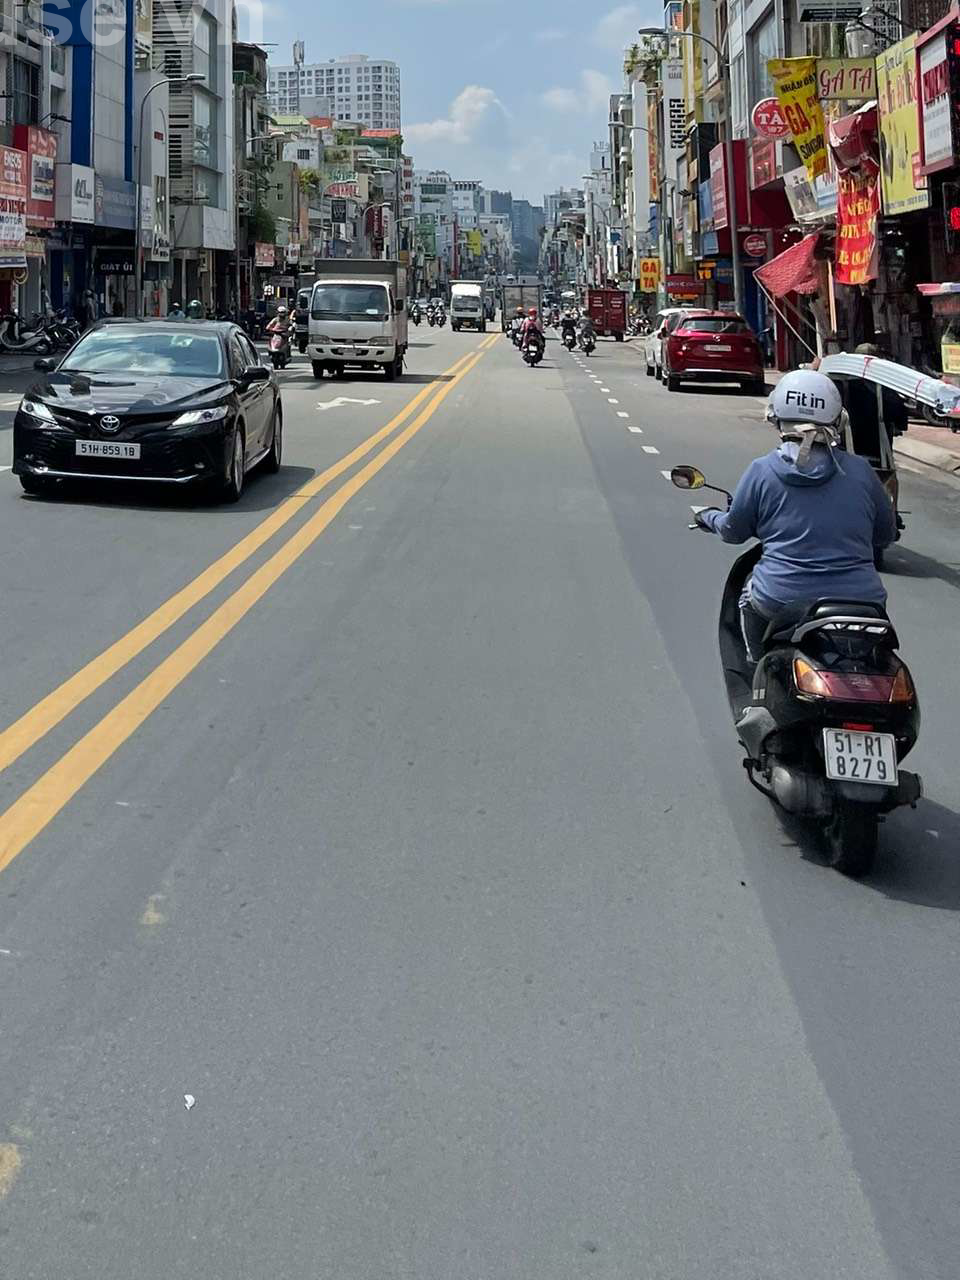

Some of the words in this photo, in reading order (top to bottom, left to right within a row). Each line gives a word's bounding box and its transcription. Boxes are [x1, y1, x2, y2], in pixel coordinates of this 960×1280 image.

[849, 67, 873, 94] TA
[785, 390, 807, 408] Fit
[811, 392, 825, 409] in
[836, 756, 887, 780] 8279
